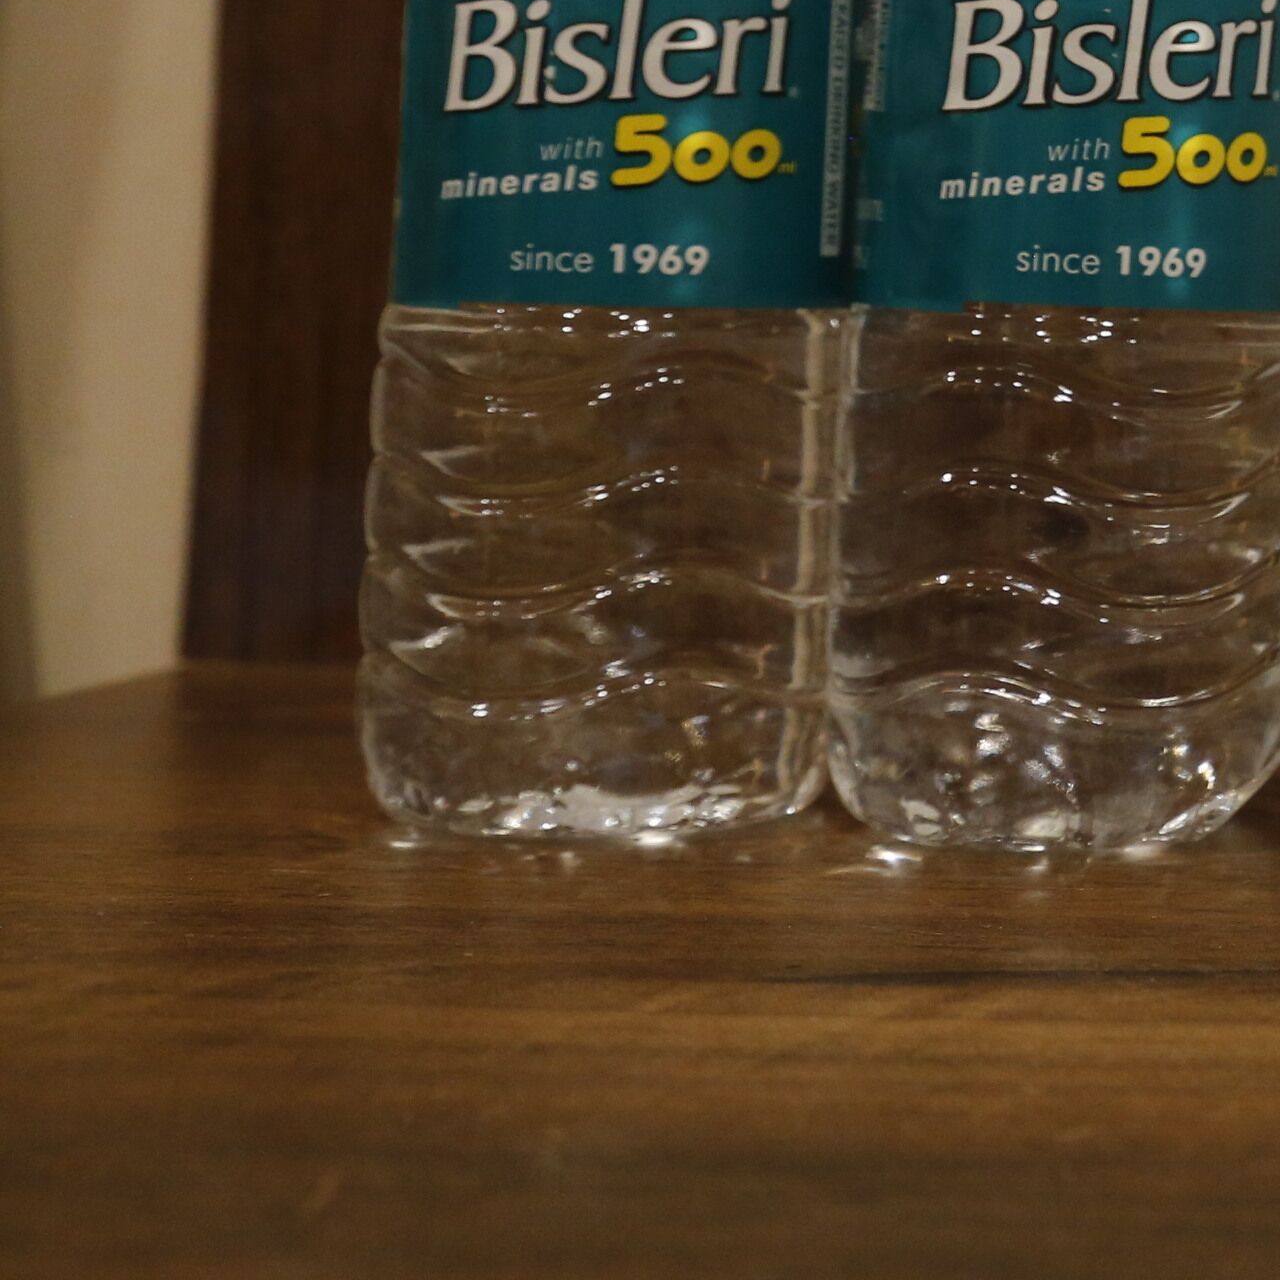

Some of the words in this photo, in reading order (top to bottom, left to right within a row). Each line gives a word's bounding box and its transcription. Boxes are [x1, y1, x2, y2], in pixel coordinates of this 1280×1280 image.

[540, 136, 603, 161] with
[611, 113, 783, 187] 500
[1048, 137, 1110, 162] with
[1117, 115, 1268, 188] 500
[440, 165, 600, 200] minerals
[939, 166, 1106, 200] minerals
[509, 242, 594, 272] since
[609, 243, 709, 275] 1969
[1015, 244, 1100, 275] since
[1115, 244, 1207, 278] 1969
